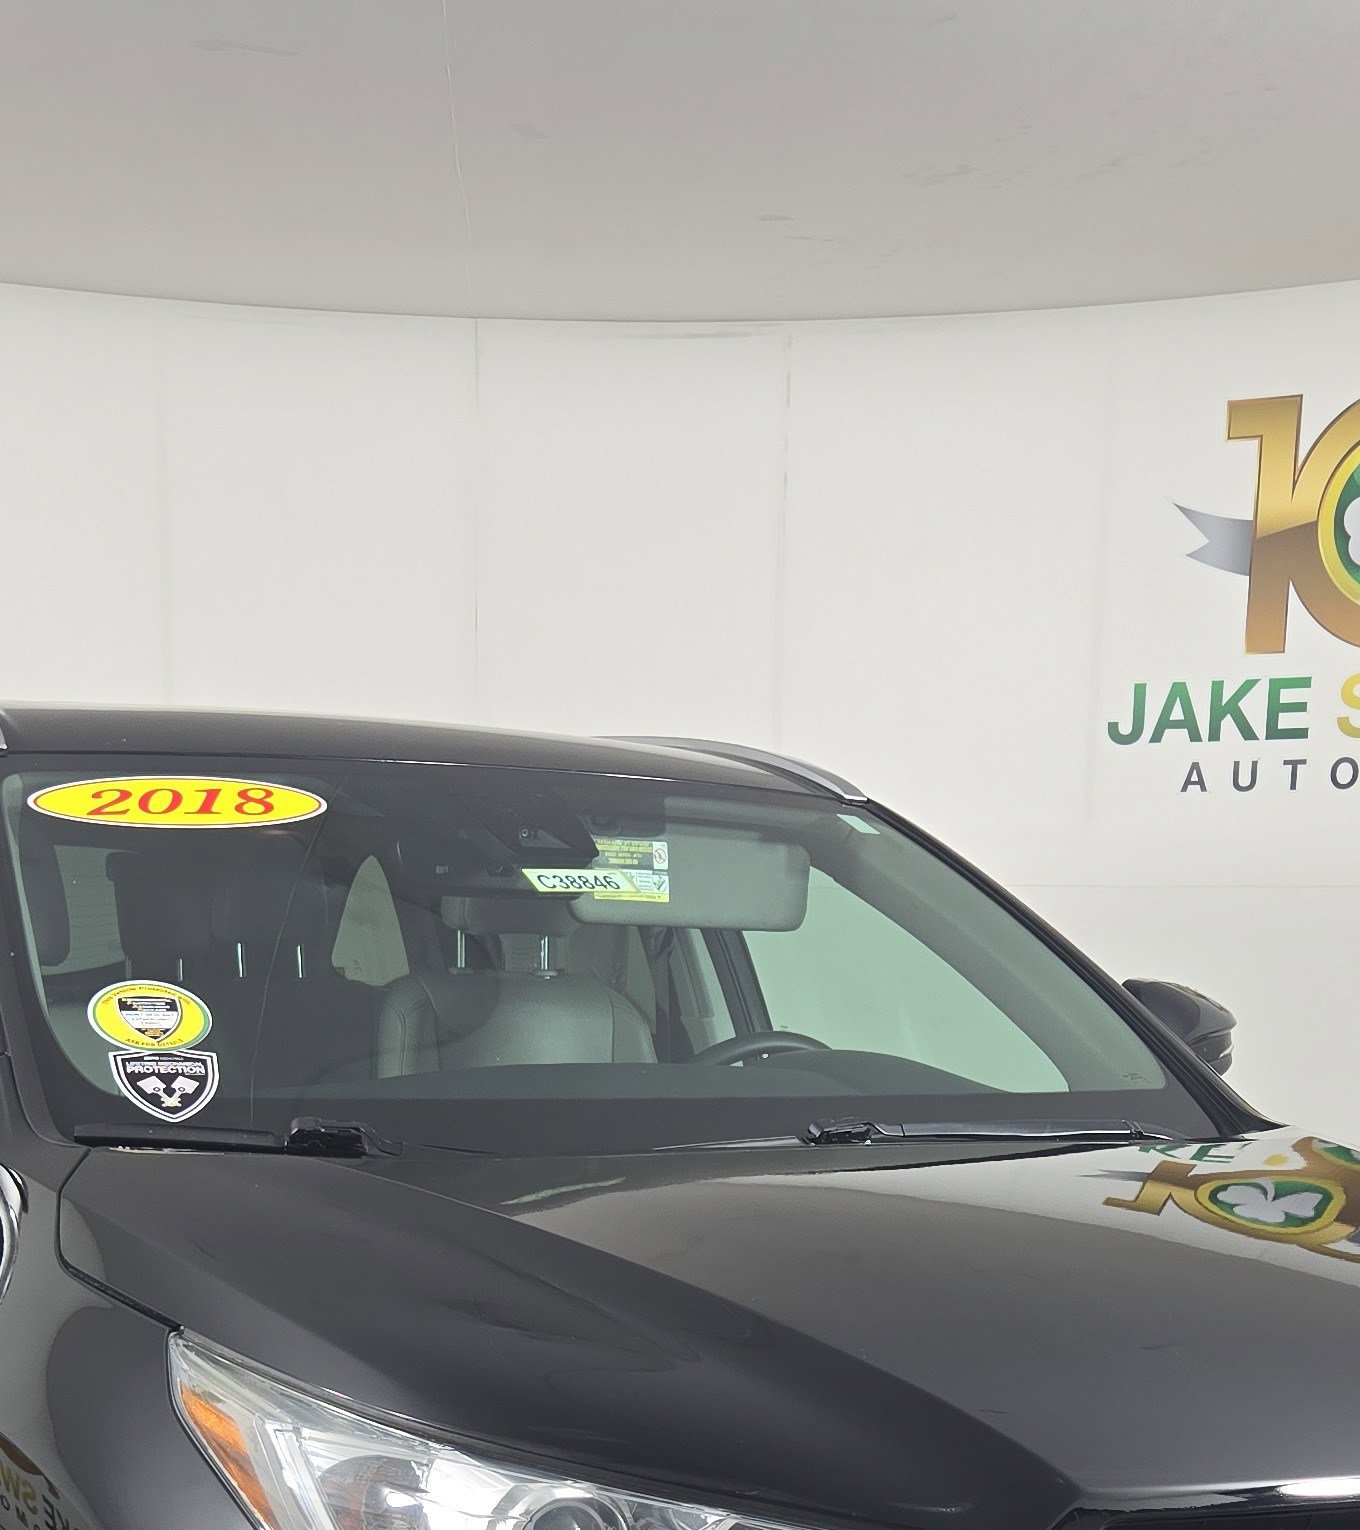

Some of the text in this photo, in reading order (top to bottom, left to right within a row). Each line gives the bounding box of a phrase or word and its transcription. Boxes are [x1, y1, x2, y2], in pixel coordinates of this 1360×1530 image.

[1107, 676, 1313, 746] JAKE
[86, 788, 275, 815] 2018
[537, 874, 621, 890] C38846
